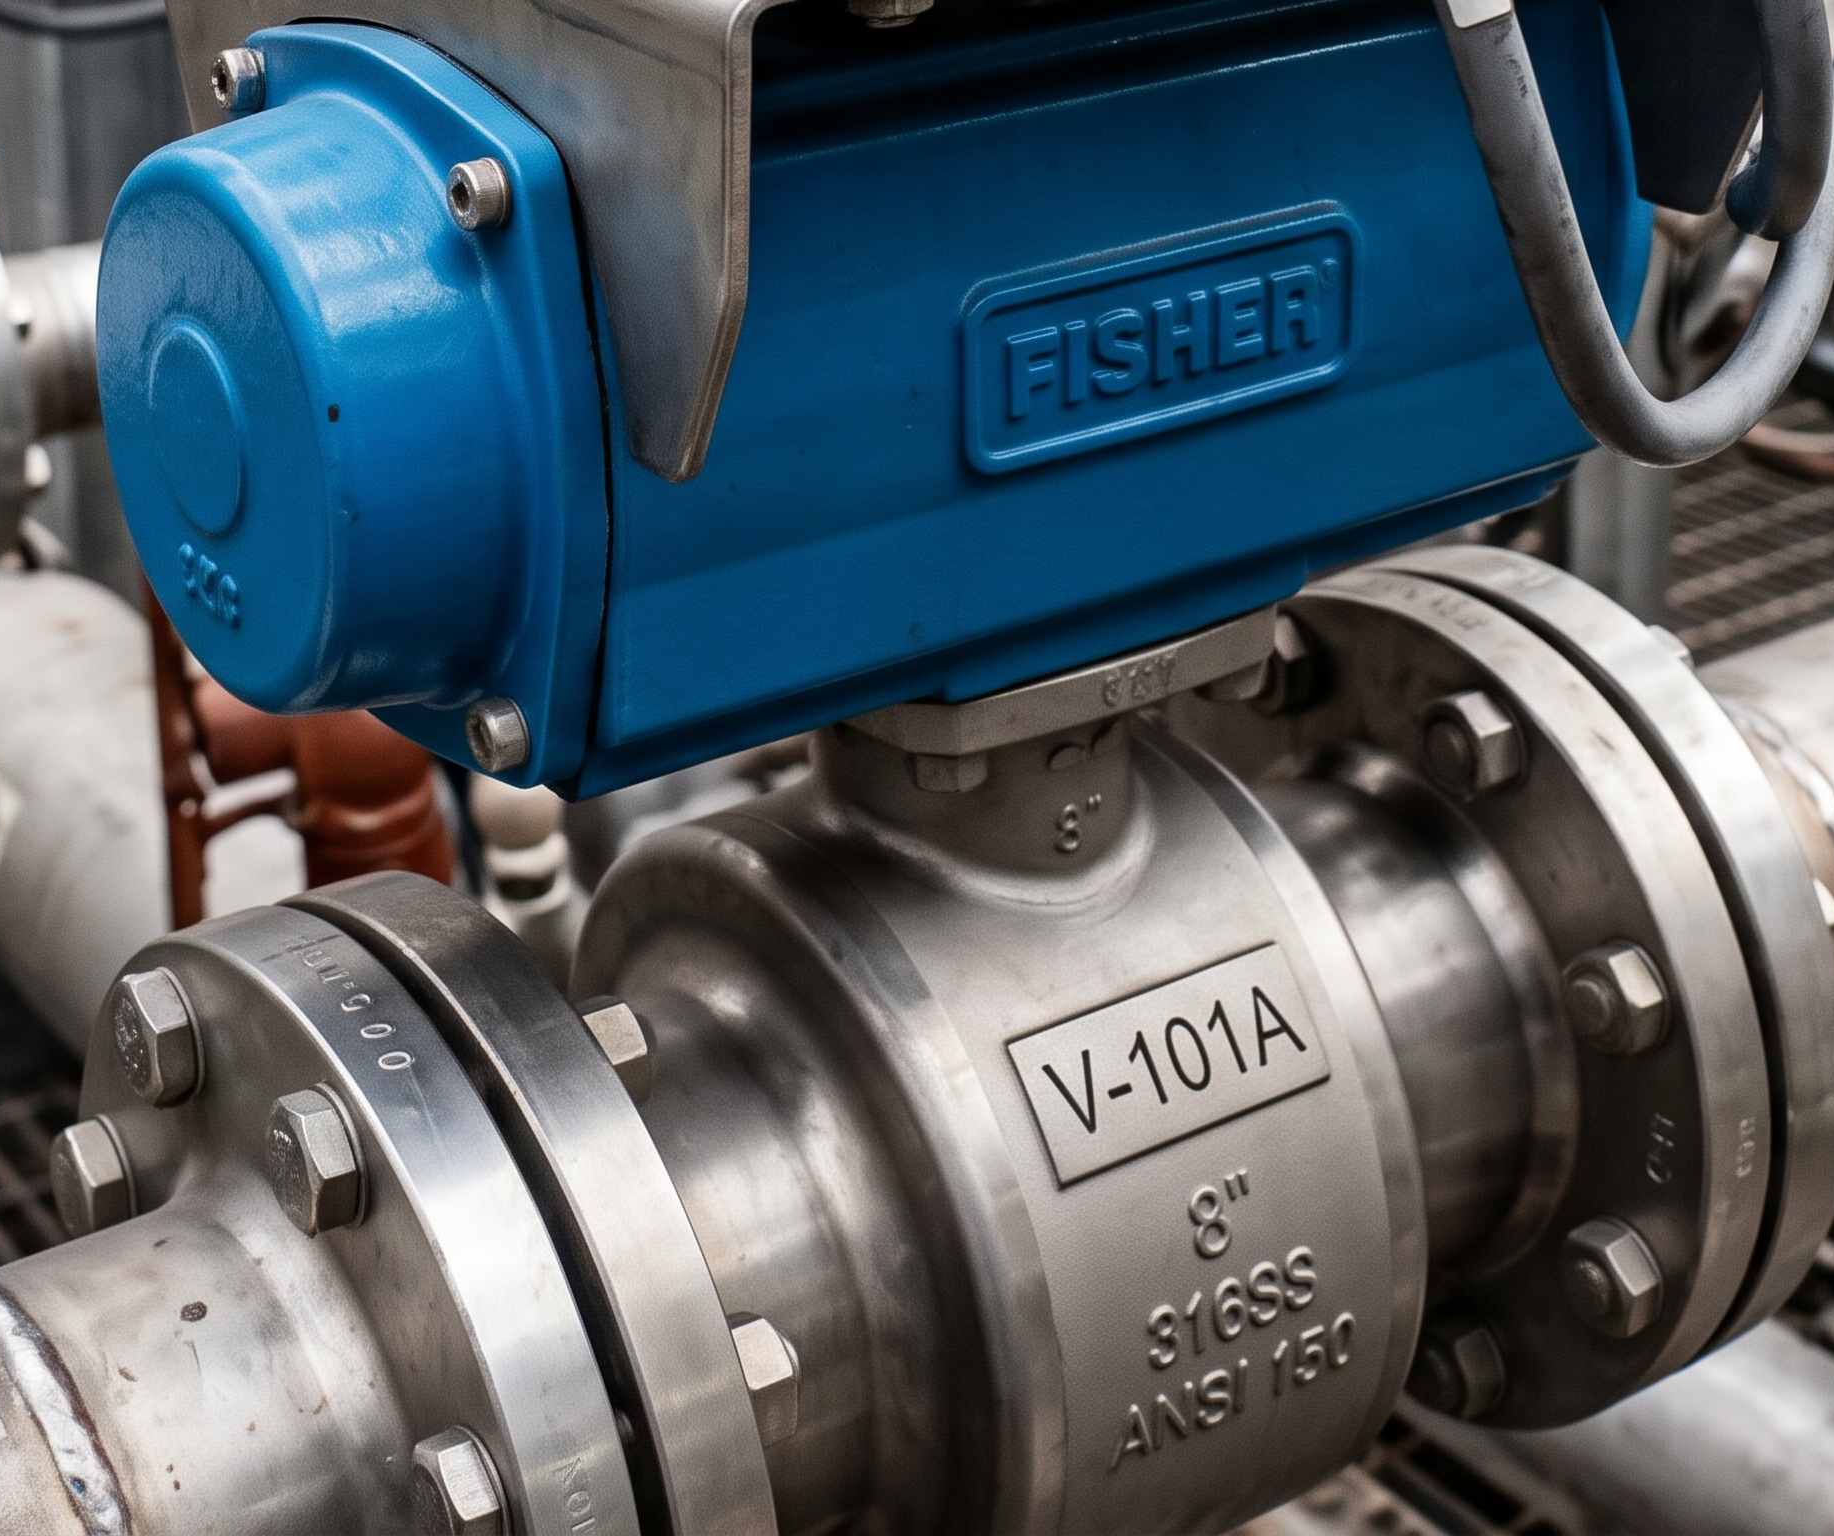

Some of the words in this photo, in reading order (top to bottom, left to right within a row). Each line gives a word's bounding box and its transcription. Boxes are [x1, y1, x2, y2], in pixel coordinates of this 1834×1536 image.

[1005, 264, 1321, 424] FISHER
[1041, 985, 1307, 1135] V-101A
[1187, 1168, 1252, 1259] 8"
[1146, 1245, 1320, 1369] 316SS
[1110, 1355, 1250, 1472] ANSI
[1268, 1311, 1360, 1397] 150
